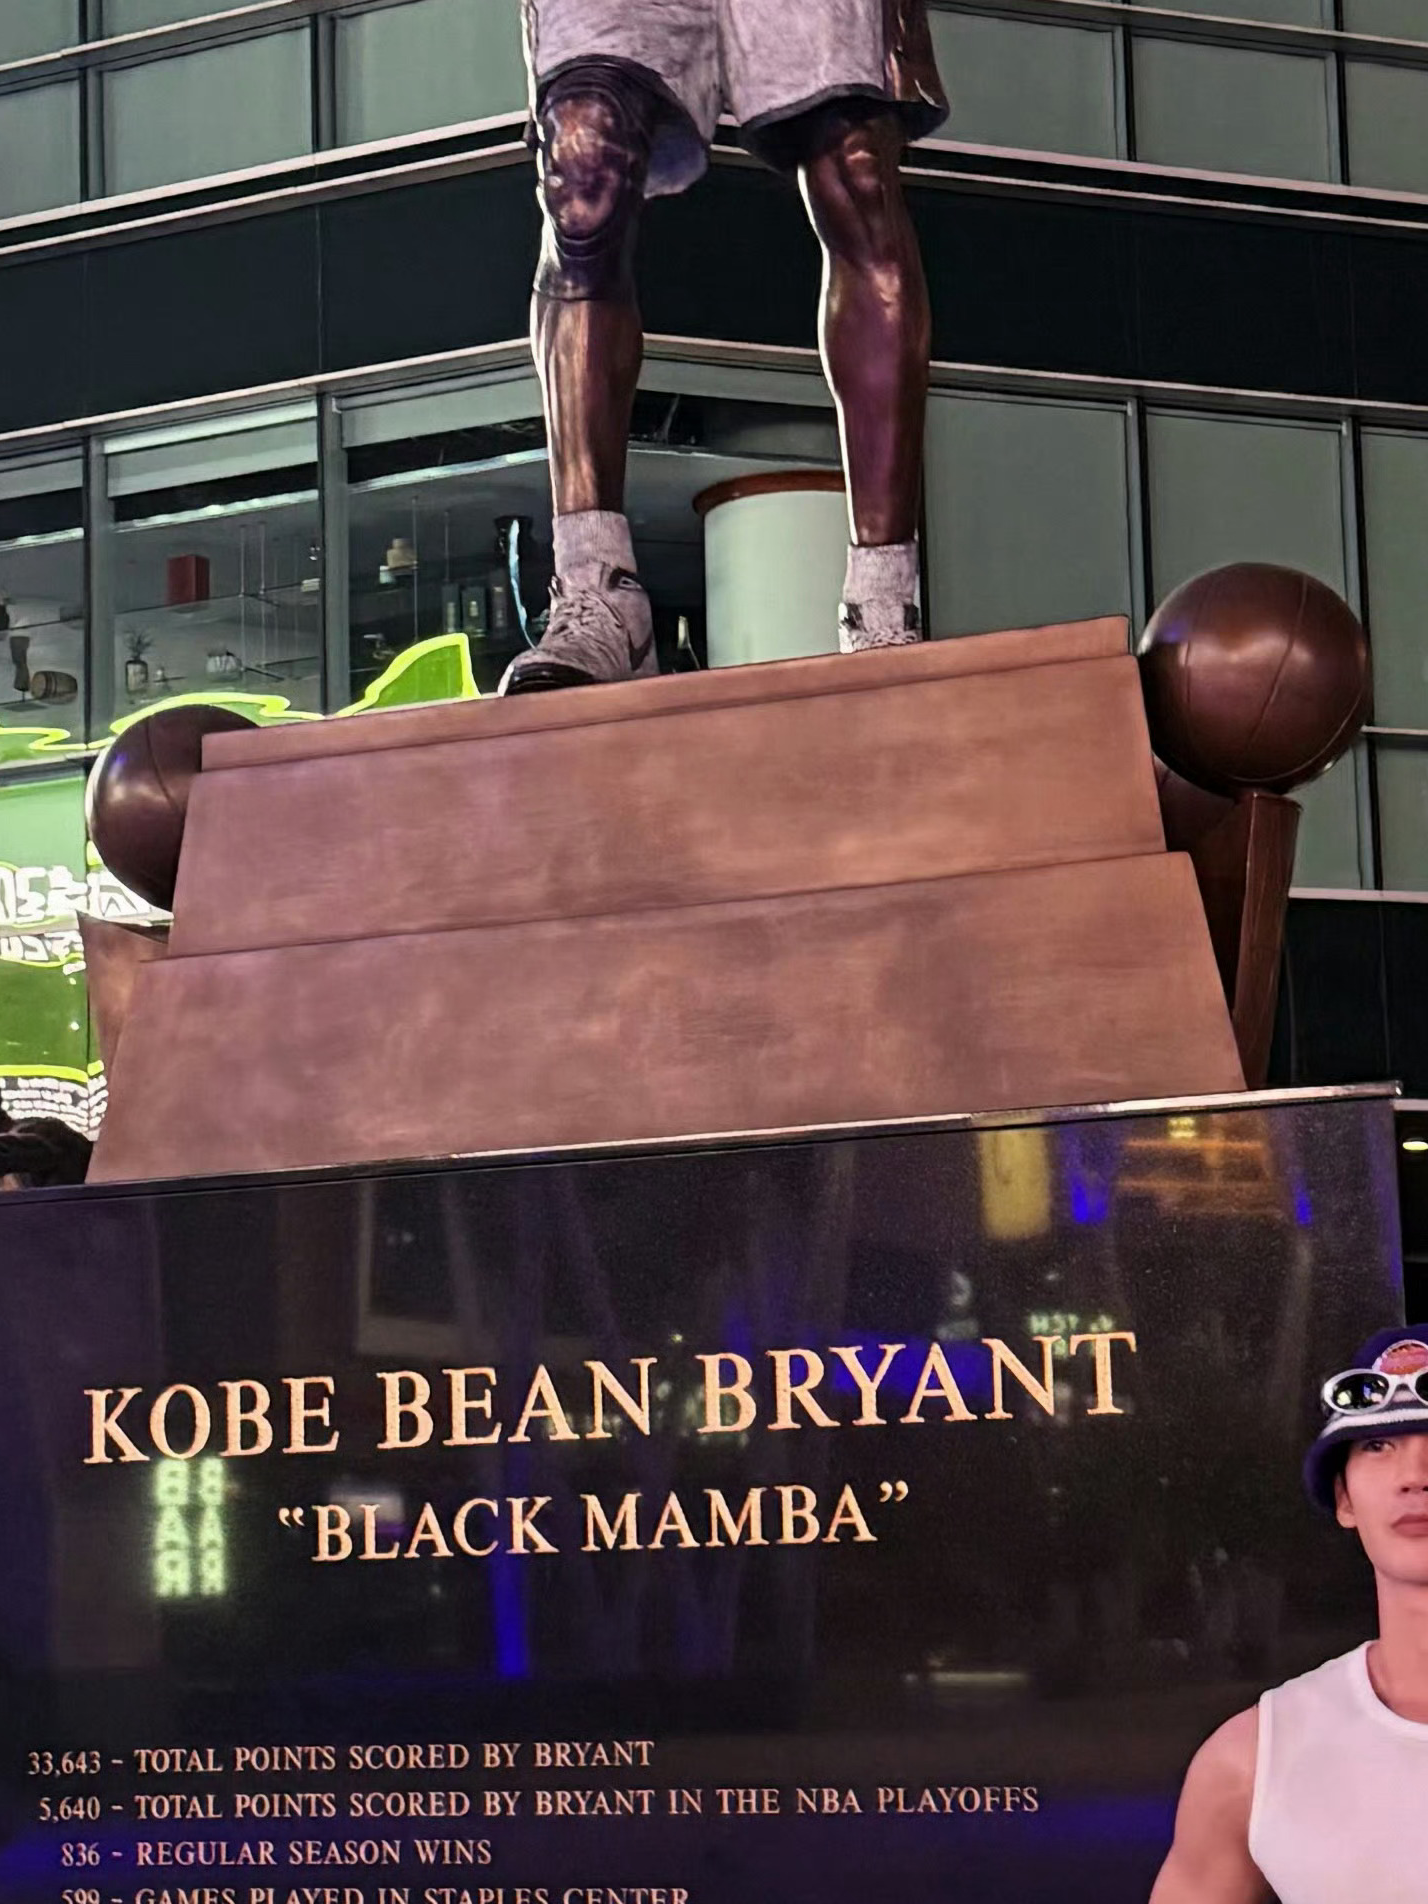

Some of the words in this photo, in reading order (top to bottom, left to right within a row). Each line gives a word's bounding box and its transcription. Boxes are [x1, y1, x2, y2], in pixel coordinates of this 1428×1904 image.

[82, 1375, 340, 1465] KOBE
[375, 1356, 658, 1450] BEAN
[694, 1331, 1138, 1434] BRYANT
[277, 1497, 560, 1562] “BLACK
[579, 1479, 910, 1553] MAMBA”
[27, 1750, 101, 1777] 33,643
[133, 1747, 224, 1774] TOTAL
[233, 1745, 336, 1772] POINTS
[348, 1743, 470, 1770] SCORED
[482, 1742, 522, 1769] BY
[533, 1740, 655, 1768] BRYANT
[38, 1795, 101, 1824] 5,640
[133, 1793, 223, 1820] TOTAL
[234, 1792, 337, 1819] POINTS
[349, 1791, 471, 1818] SCORED
[483, 1790, 522, 1817] BY
[535, 1789, 656, 1816] BRYANT
[668, 1788, 703, 1815] IN
[715, 1788, 781, 1815] THE
[795, 1787, 864, 1814] NBA
[877, 1786, 1039, 1814] PLAYOFFS
[61, 1842, 101, 1867] 836
[136, 1840, 278, 1867] REGULAR
[288, 1839, 402, 1866] SEASON
[413, 1838, 492, 1865] WINS
